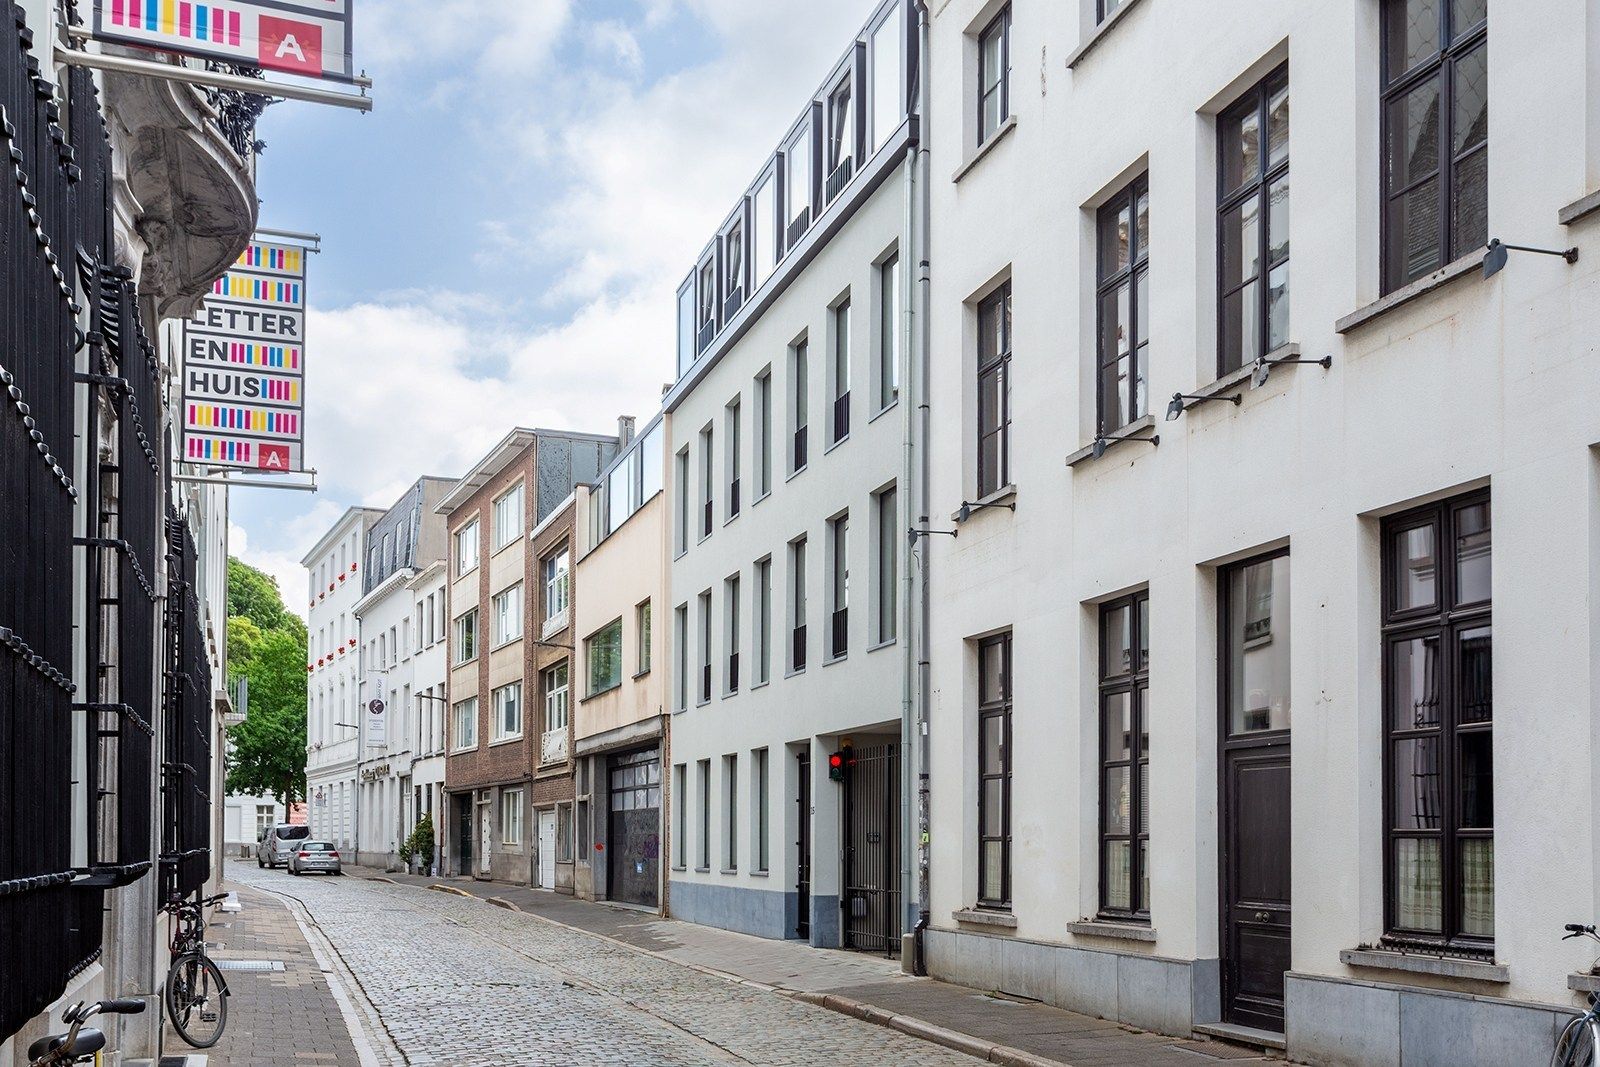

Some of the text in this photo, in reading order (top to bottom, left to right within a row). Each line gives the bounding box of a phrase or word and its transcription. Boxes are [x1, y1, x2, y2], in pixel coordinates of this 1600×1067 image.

[275, 33, 306, 63] A
[190, 338, 228, 362] EN
[190, 371, 260, 398] HUIS
[266, 450, 282, 468] A
